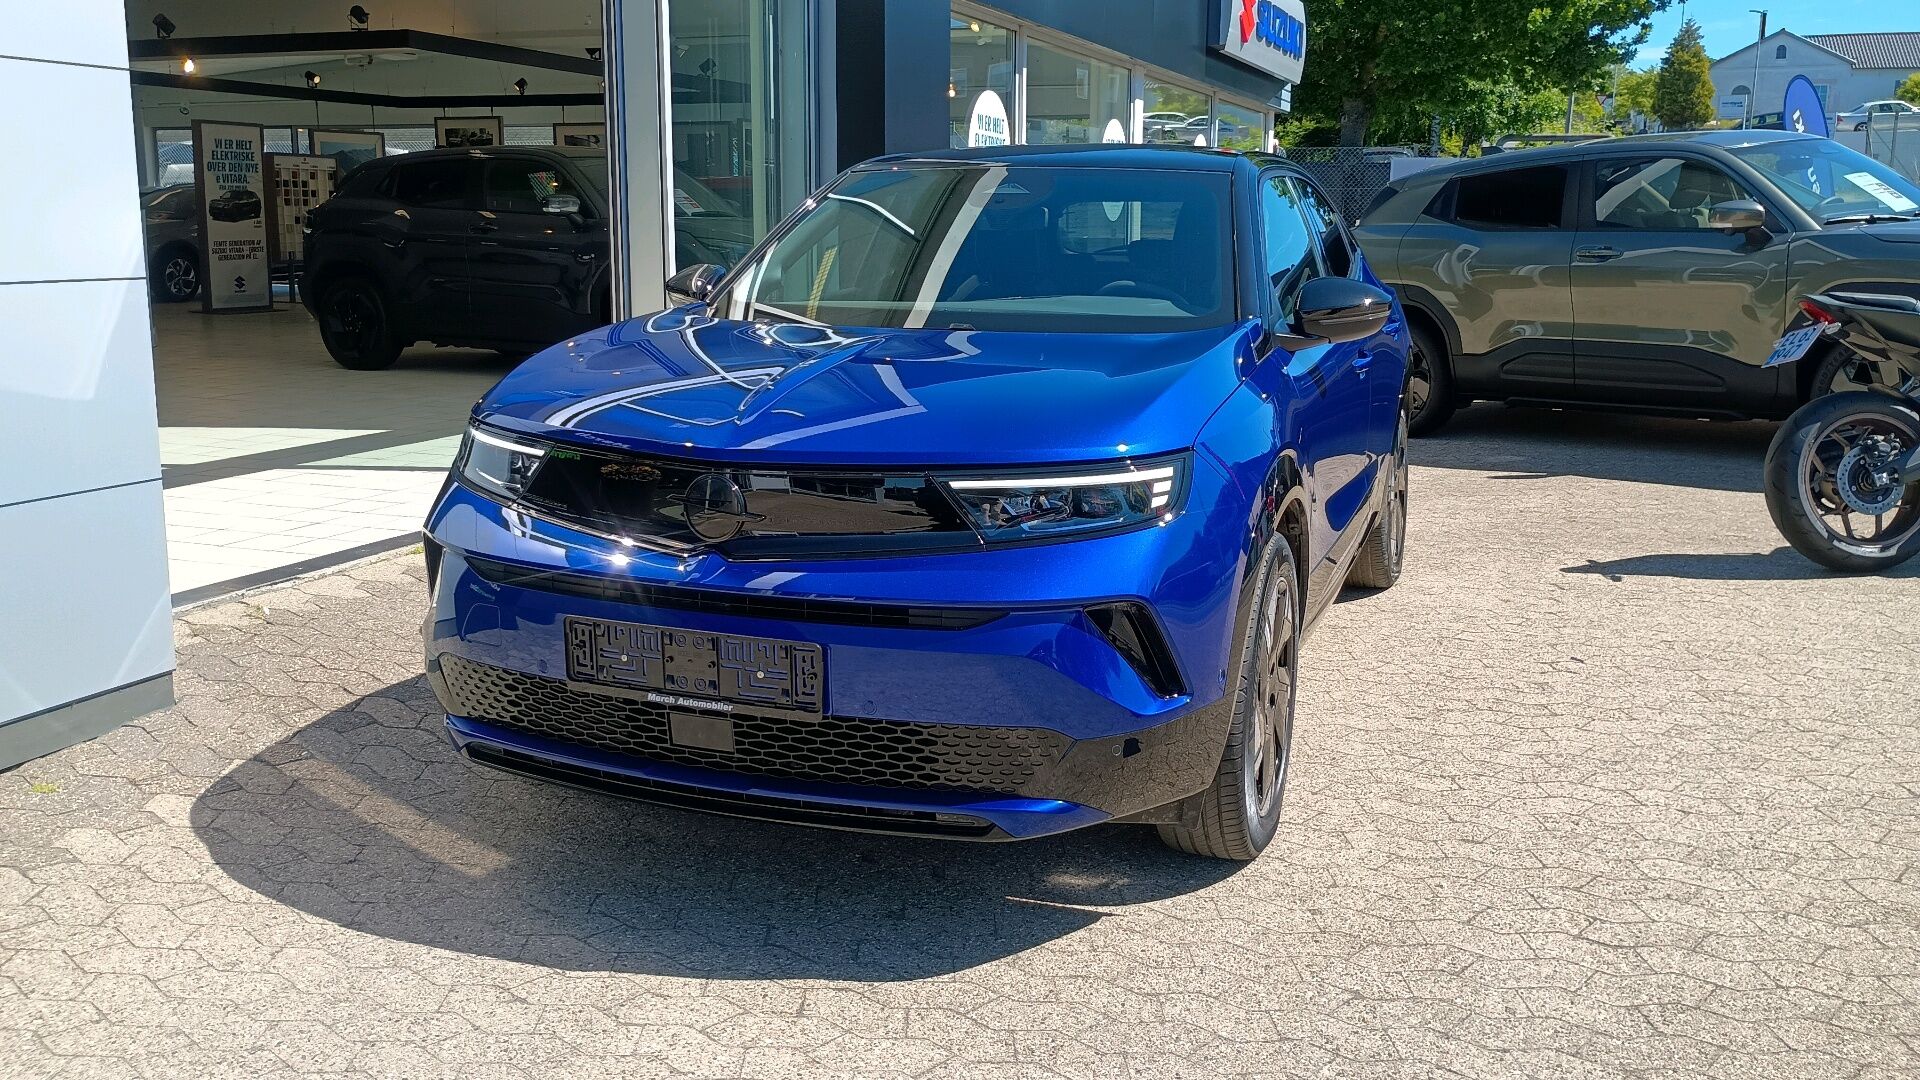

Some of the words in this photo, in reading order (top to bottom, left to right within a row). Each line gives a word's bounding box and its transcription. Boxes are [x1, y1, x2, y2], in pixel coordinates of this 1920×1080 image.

[1256, 0, 1304, 61] SUZUKI
[978, 113, 984, 130] VI
[985, 115, 992, 131] ER
[992, 117, 1005, 134] HELT
[214, 138, 223, 149] VI
[224, 139, 234, 150] ER
[235, 139, 253, 150] HELT
[211, 150, 255, 162] ELEKTRISKE
[207, 161, 226, 172] OVER
[228, 162, 243, 173] DEN
[245, 163, 259, 173] NYE
[221, 173, 250, 184] VITARA.
[1773, 343, 1803, 361] 947
[677, 697, 734, 712] Automobiler
